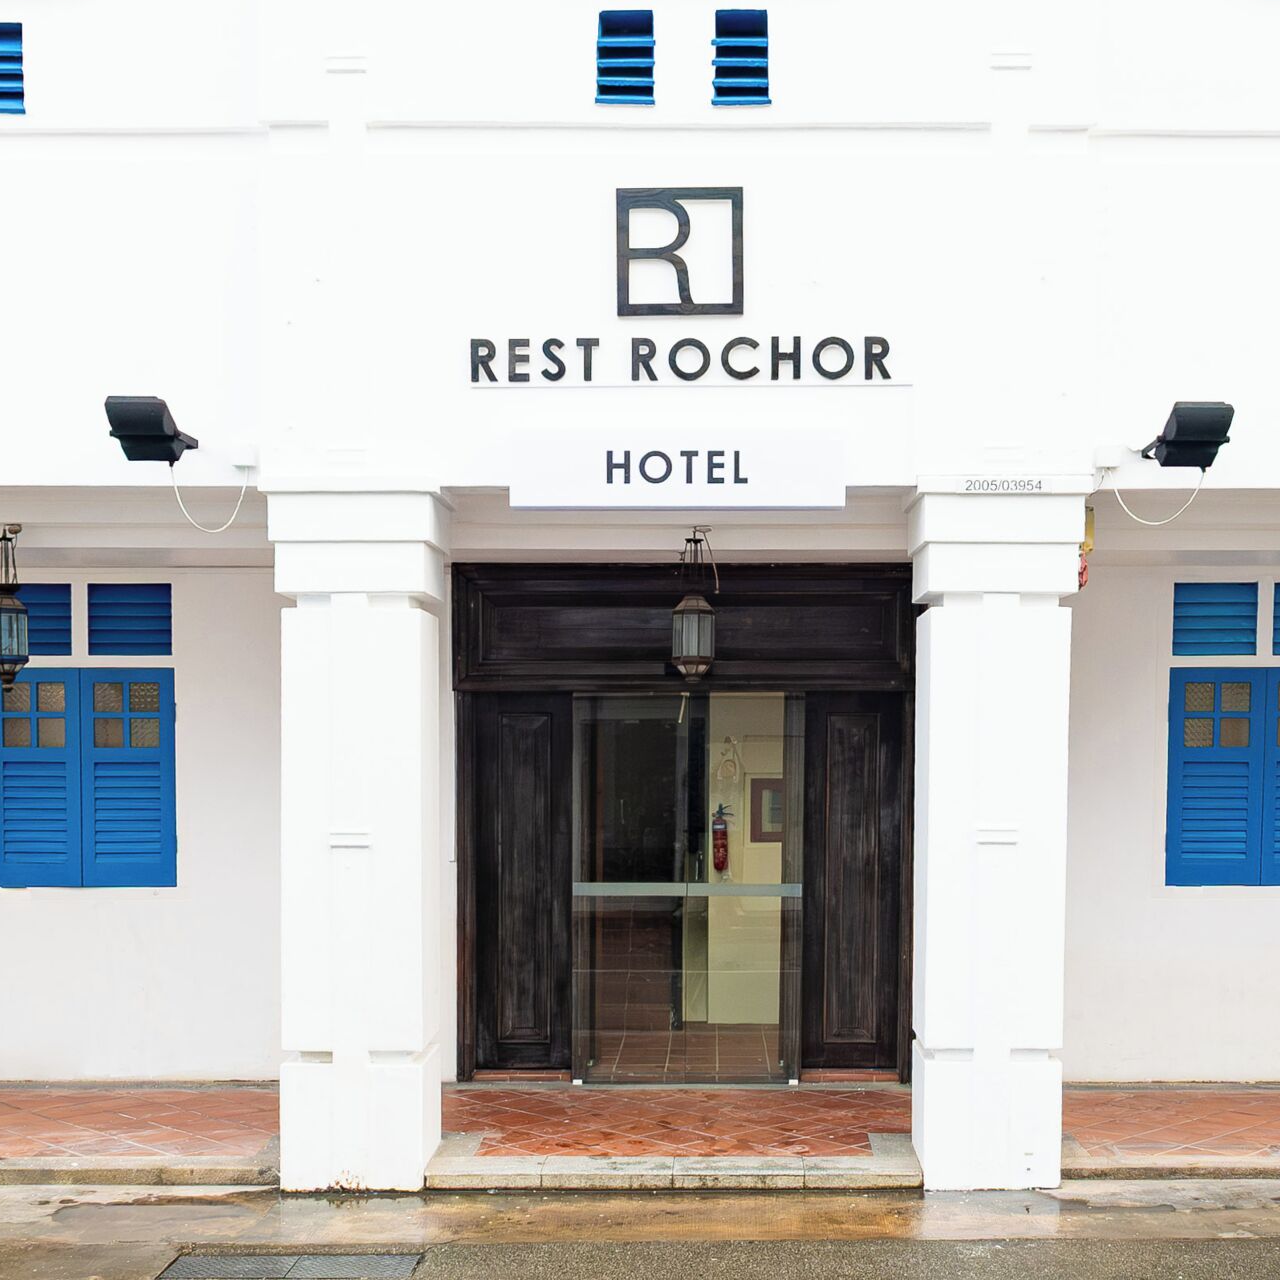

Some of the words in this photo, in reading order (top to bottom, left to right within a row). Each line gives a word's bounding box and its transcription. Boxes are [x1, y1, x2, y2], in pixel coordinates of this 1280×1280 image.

[470, 337, 600, 382] REST
[631, 335, 892, 382] ROCHOR
[606, 450, 749, 485] HOTEL
[965, 480, 1042, 491] 2005/03954
